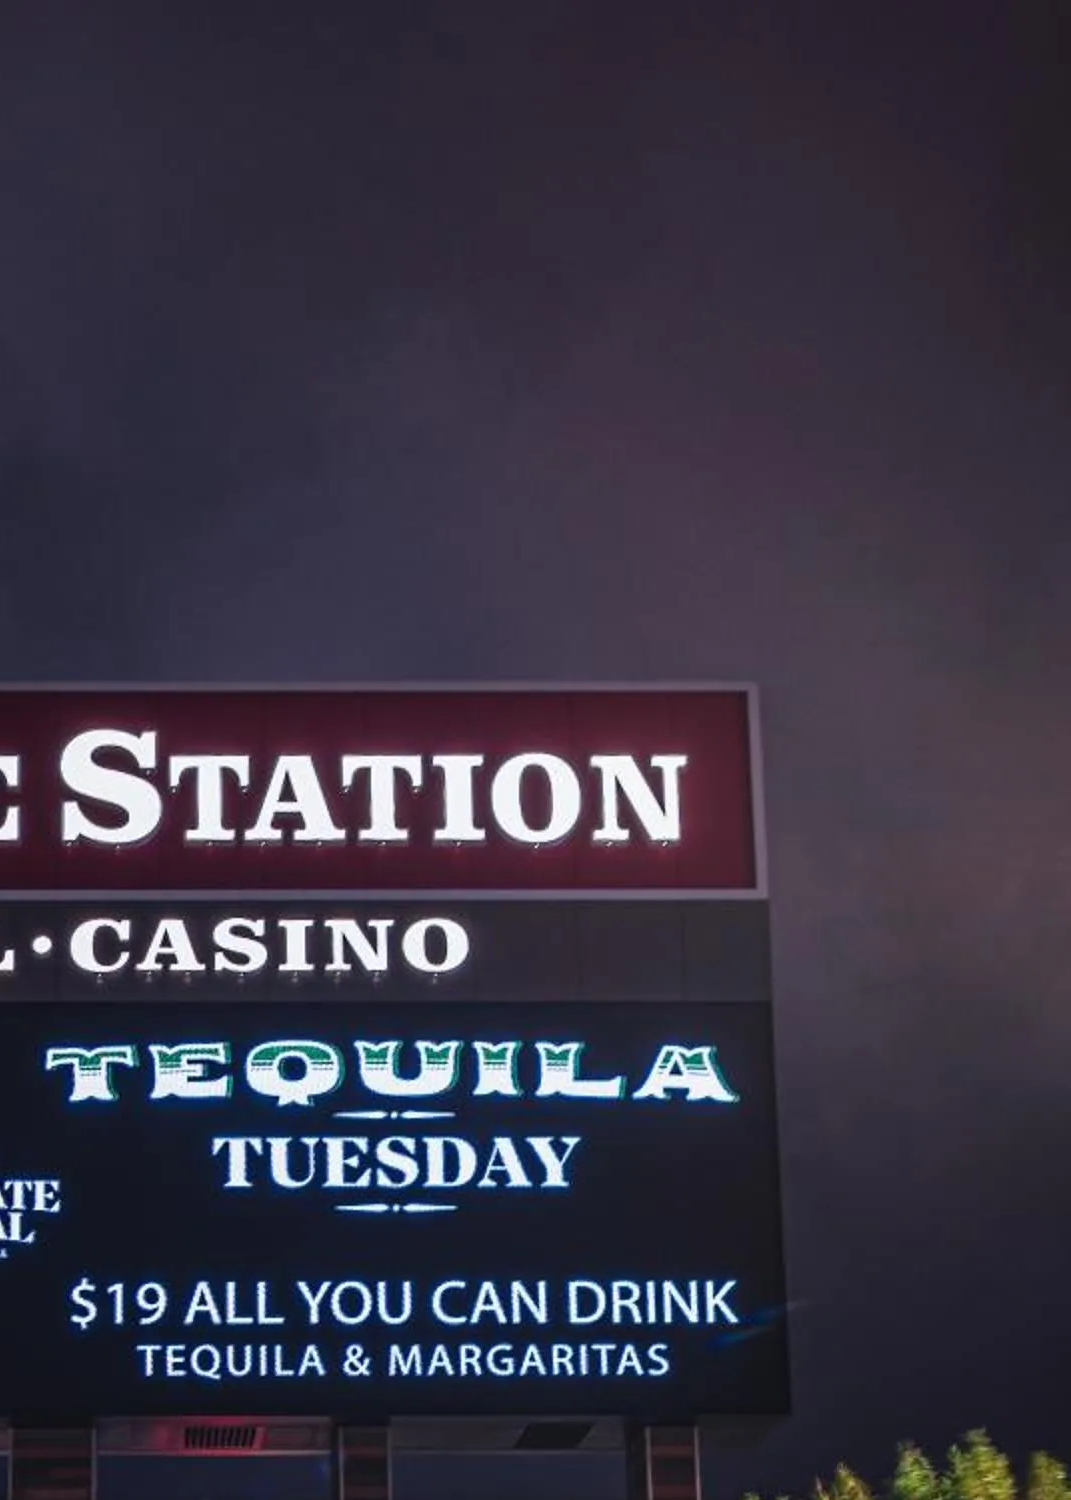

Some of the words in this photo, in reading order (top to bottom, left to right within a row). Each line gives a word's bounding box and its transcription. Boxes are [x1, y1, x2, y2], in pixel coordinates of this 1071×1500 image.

[60, 729, 687, 843] STATION
[70, 917, 469, 973] CASINO
[44, 1039, 741, 1108] TEQUILA
[211, 1135, 581, 1189] TUESDAY
[70, 1277, 168, 1330] $19
[184, 1280, 285, 1325] ALL
[296, 1280, 412, 1325] YOU
[431, 1279, 548, 1325] CAN
[568, 1279, 739, 1324] DRINK
[136, 1343, 326, 1380] TEQUILA
[342, 1343, 371, 1377] &
[388, 1343, 670, 1377] MARGARITAS
